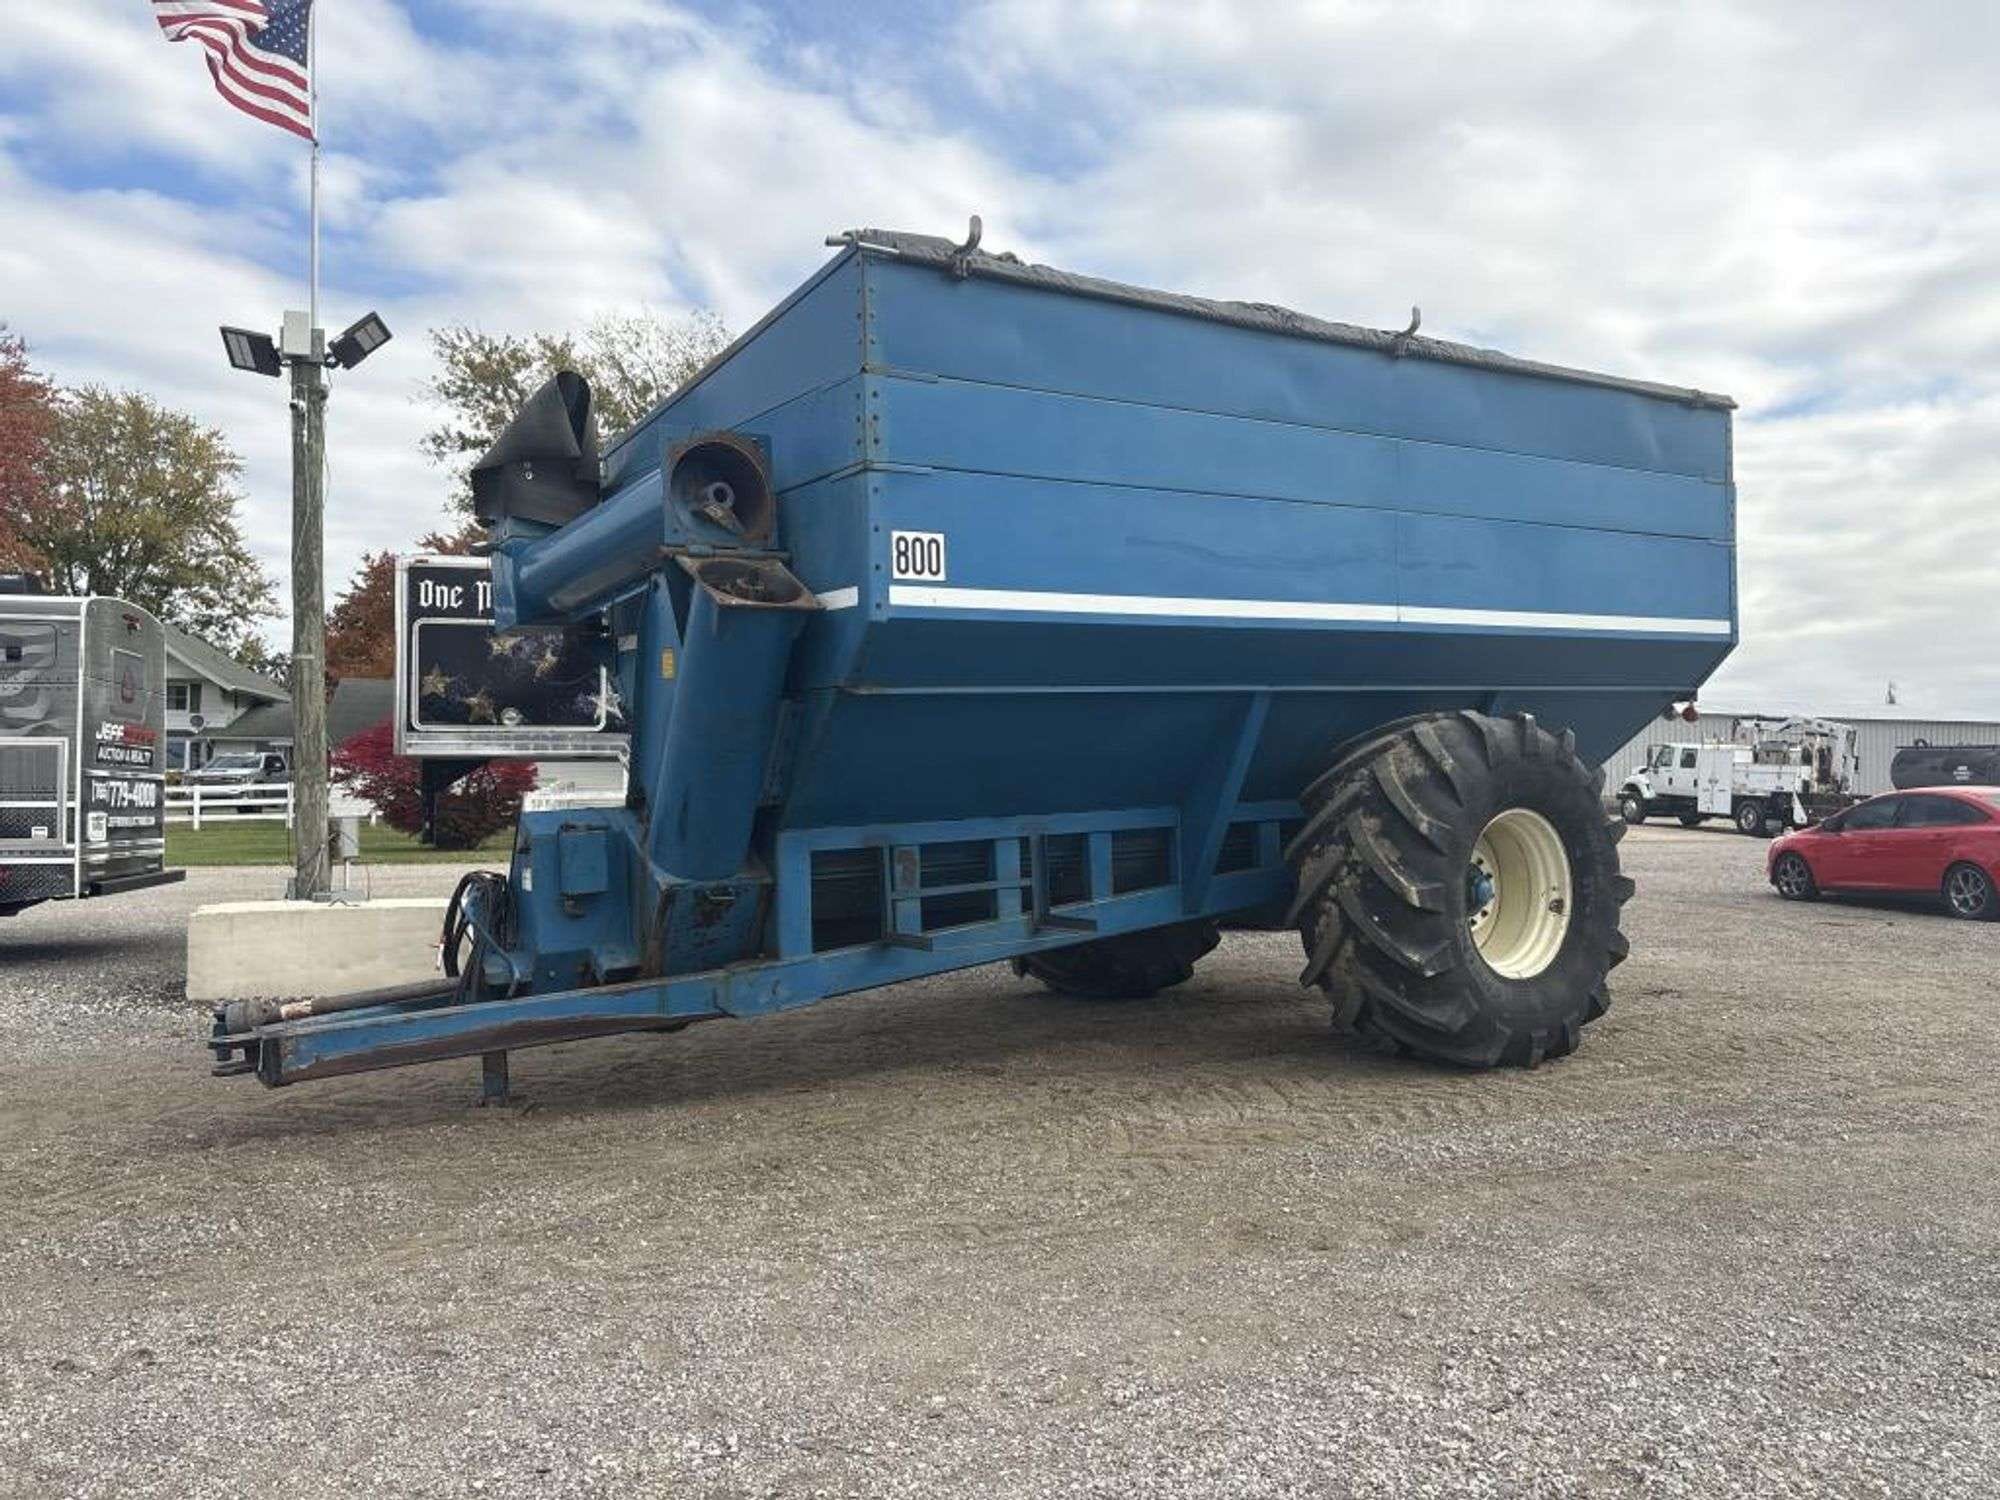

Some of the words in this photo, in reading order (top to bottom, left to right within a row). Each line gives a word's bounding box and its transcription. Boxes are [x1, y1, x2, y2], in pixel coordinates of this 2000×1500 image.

[895, 535, 941, 577] 800
[419, 579, 463, 610] One
[96, 721, 125, 740] JEFF
